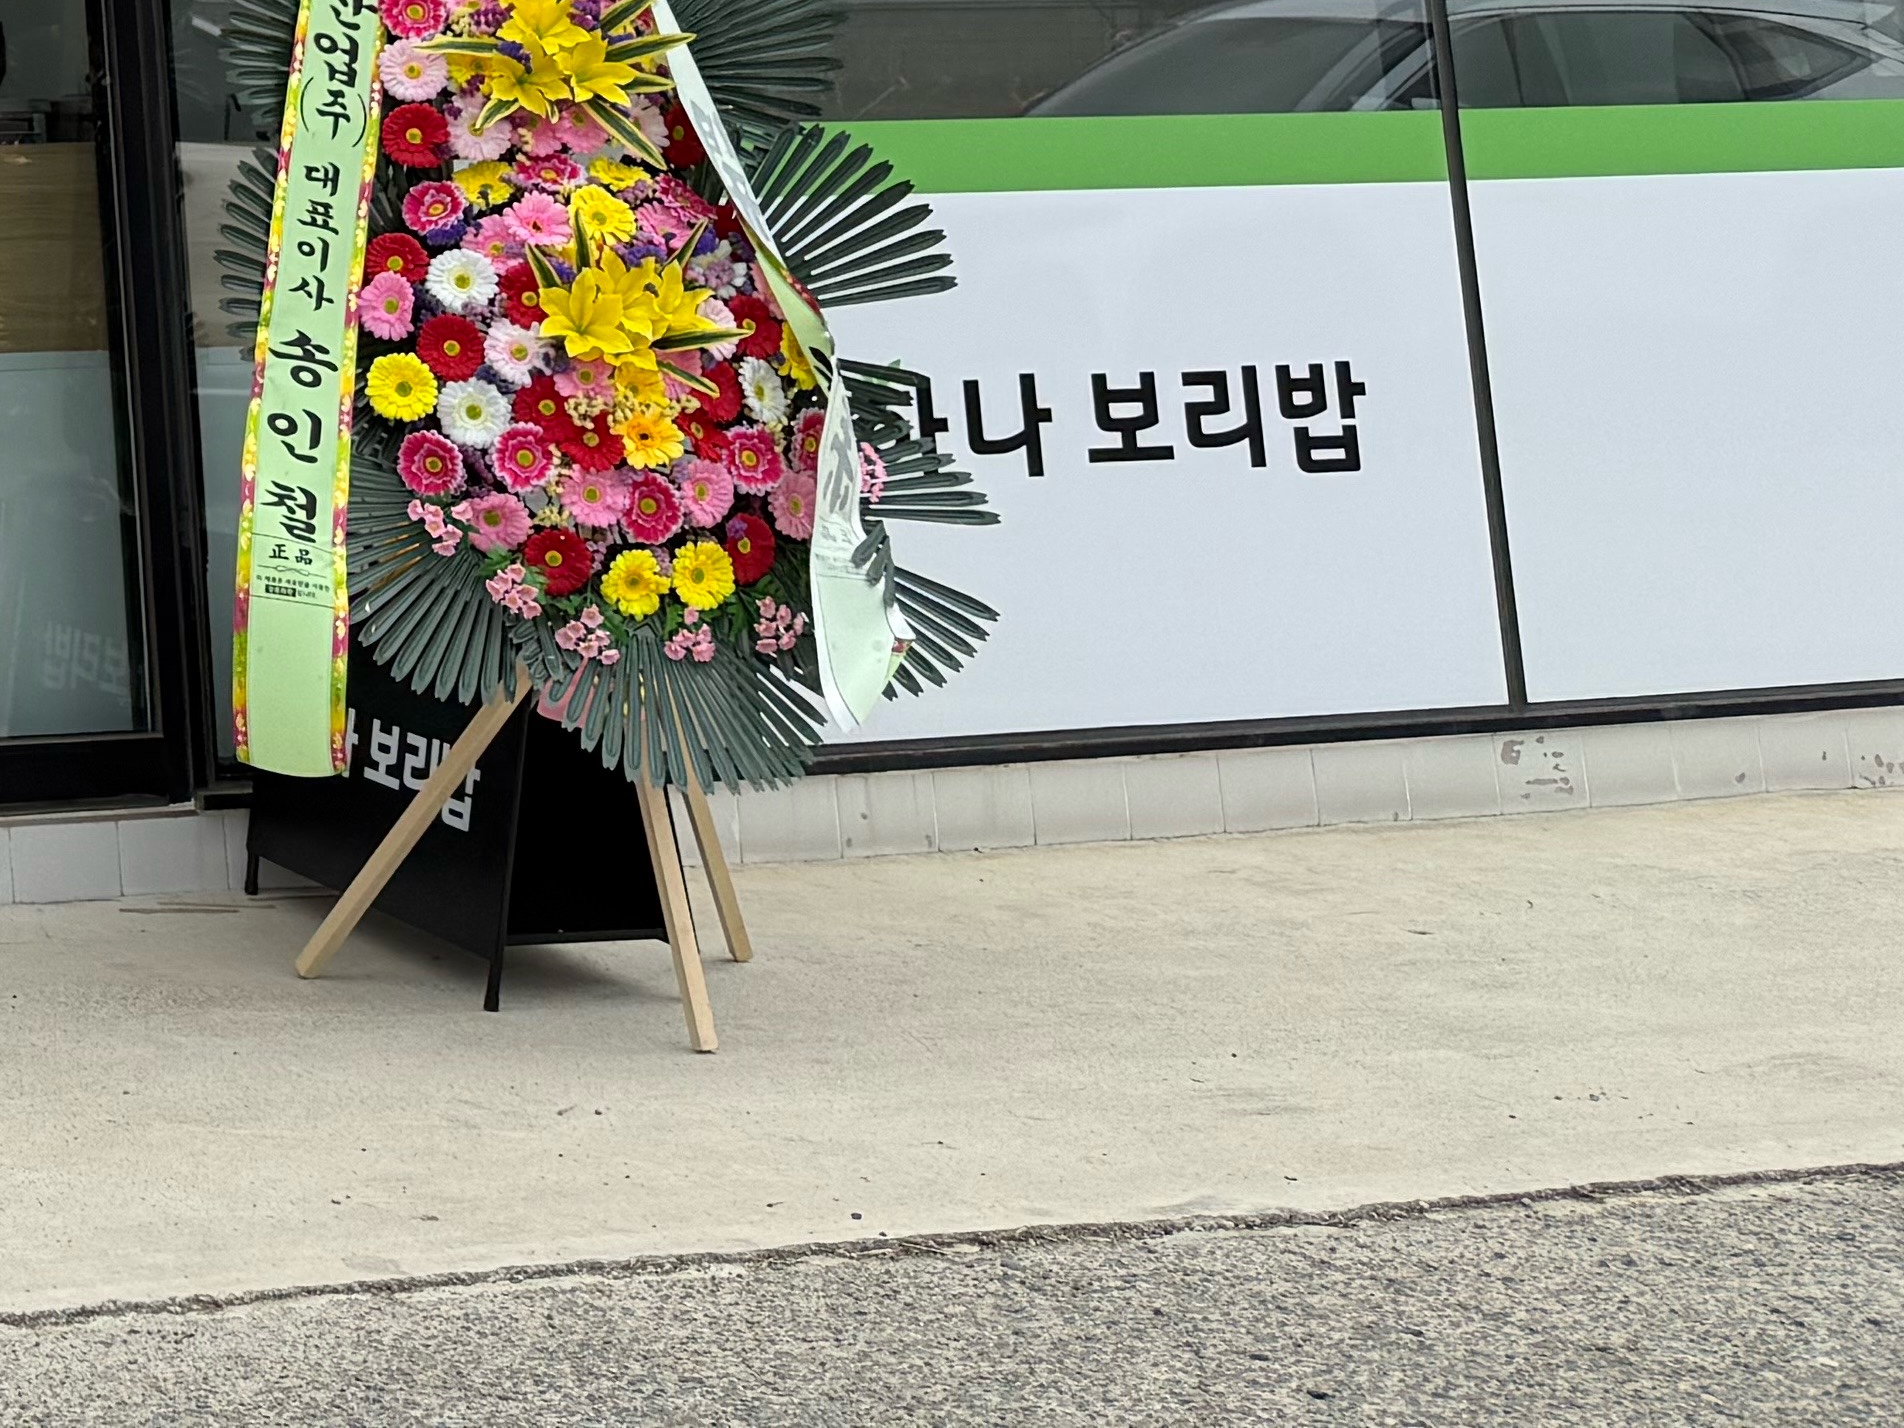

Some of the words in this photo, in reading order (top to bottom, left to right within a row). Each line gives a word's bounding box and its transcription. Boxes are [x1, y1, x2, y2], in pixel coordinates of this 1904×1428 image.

[287, 160, 341, 312] 대표이사
[259, 327, 341, 545] 송인철
[1087, 360, 1367, 474] 보리밥
[268, 543, 313, 566] 正品
